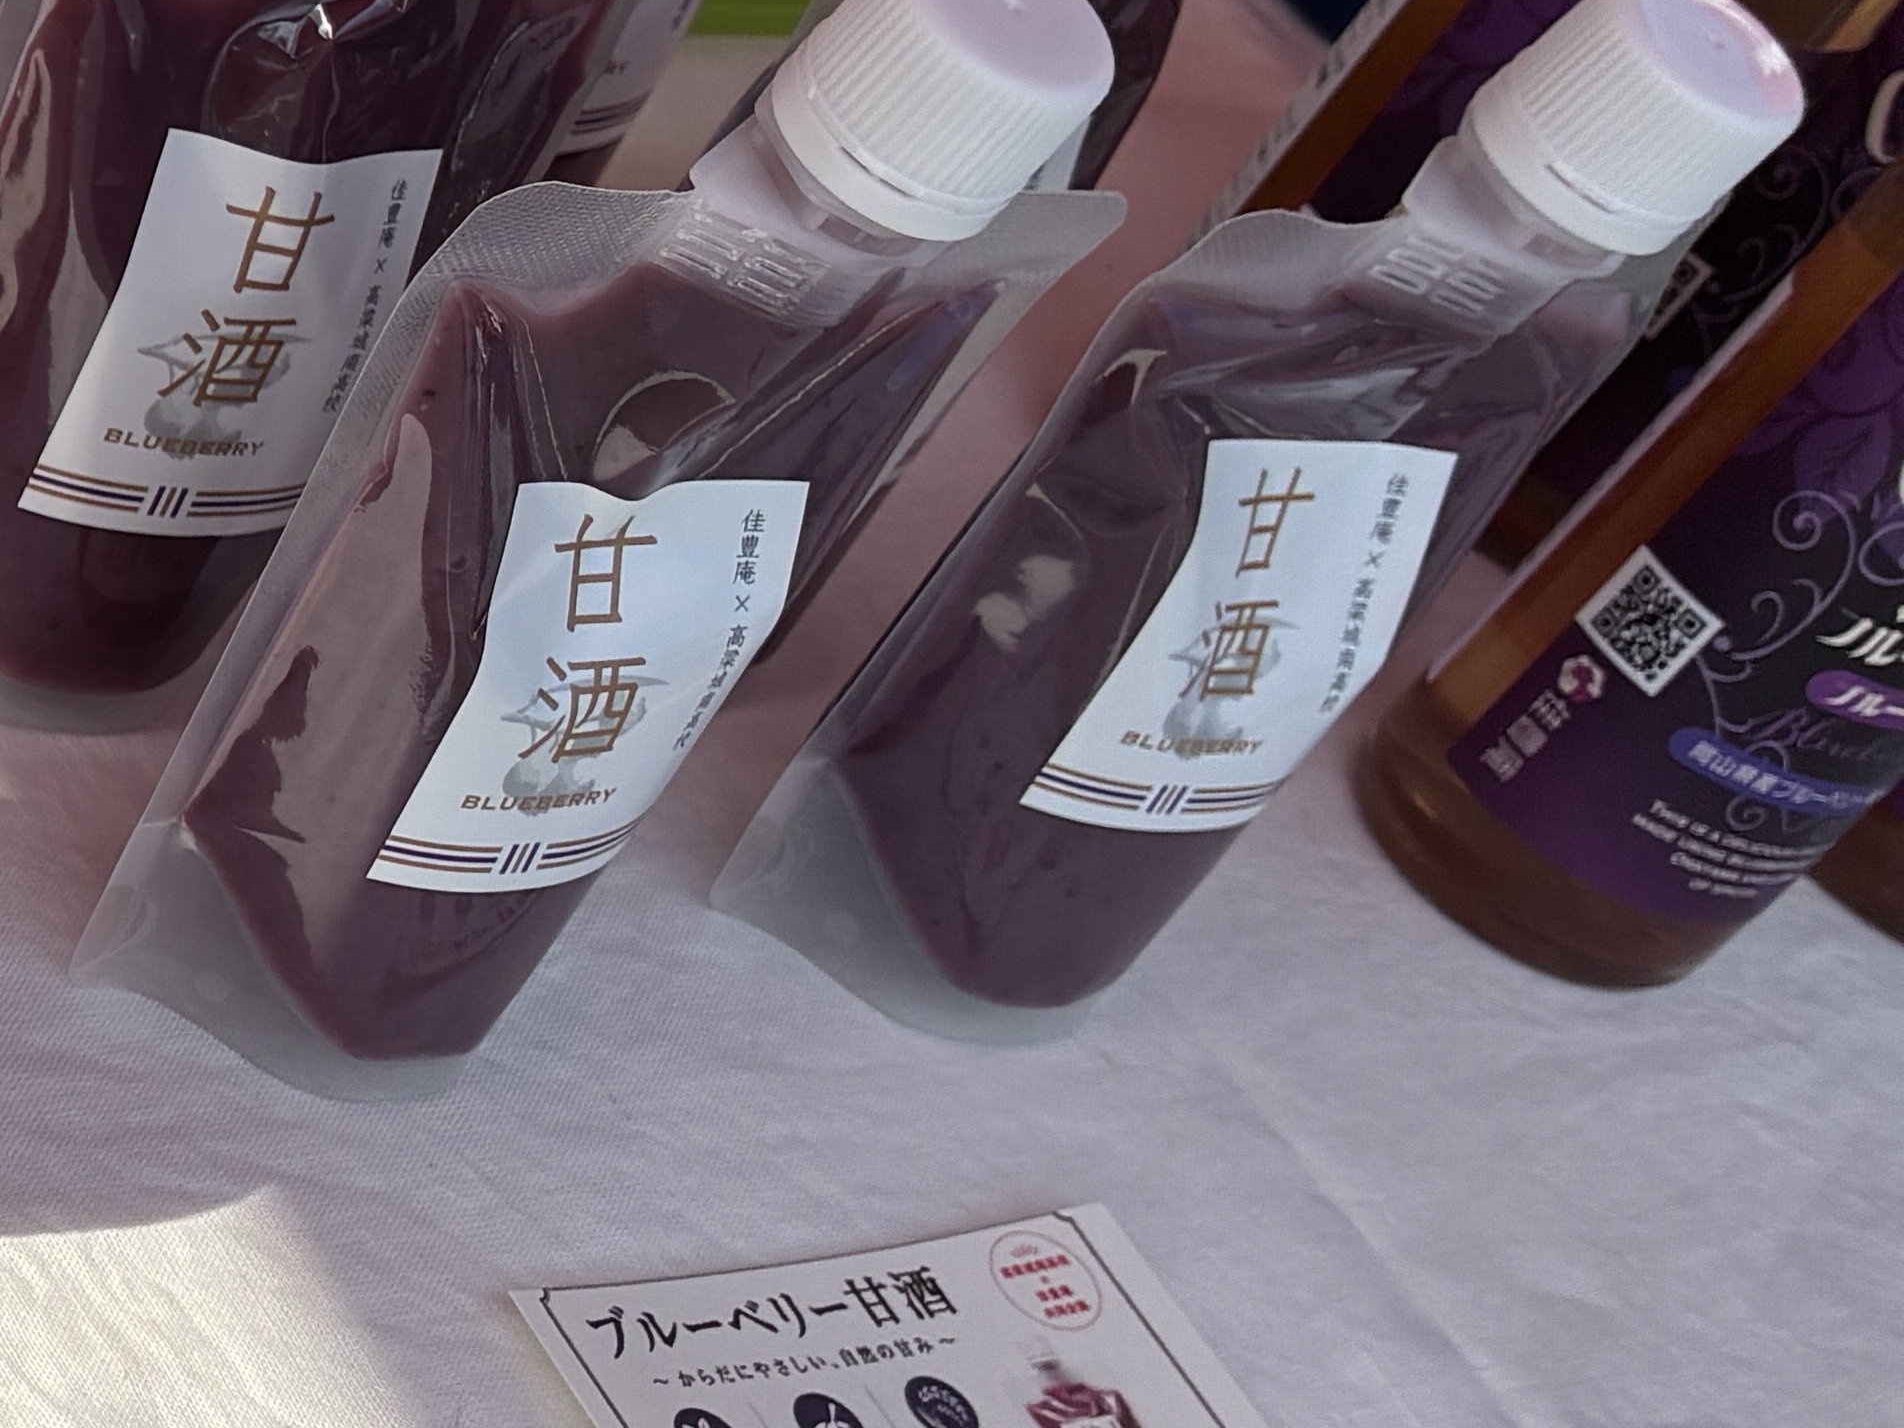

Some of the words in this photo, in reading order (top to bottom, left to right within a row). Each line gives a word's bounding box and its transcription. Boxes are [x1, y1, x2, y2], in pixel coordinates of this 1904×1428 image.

[157, 185, 335, 407] 甘酒
[103, 426, 265, 458] BLUEBERRY
[1178, 466, 1316, 703] 甘酒
[517, 513, 658, 764] 甘酒
[1120, 729, 1264, 757] BLUEBERRY
[460, 786, 617, 813] BLUEBERRY
[585, 1265, 958, 1360] ブルーベリー甘酒
